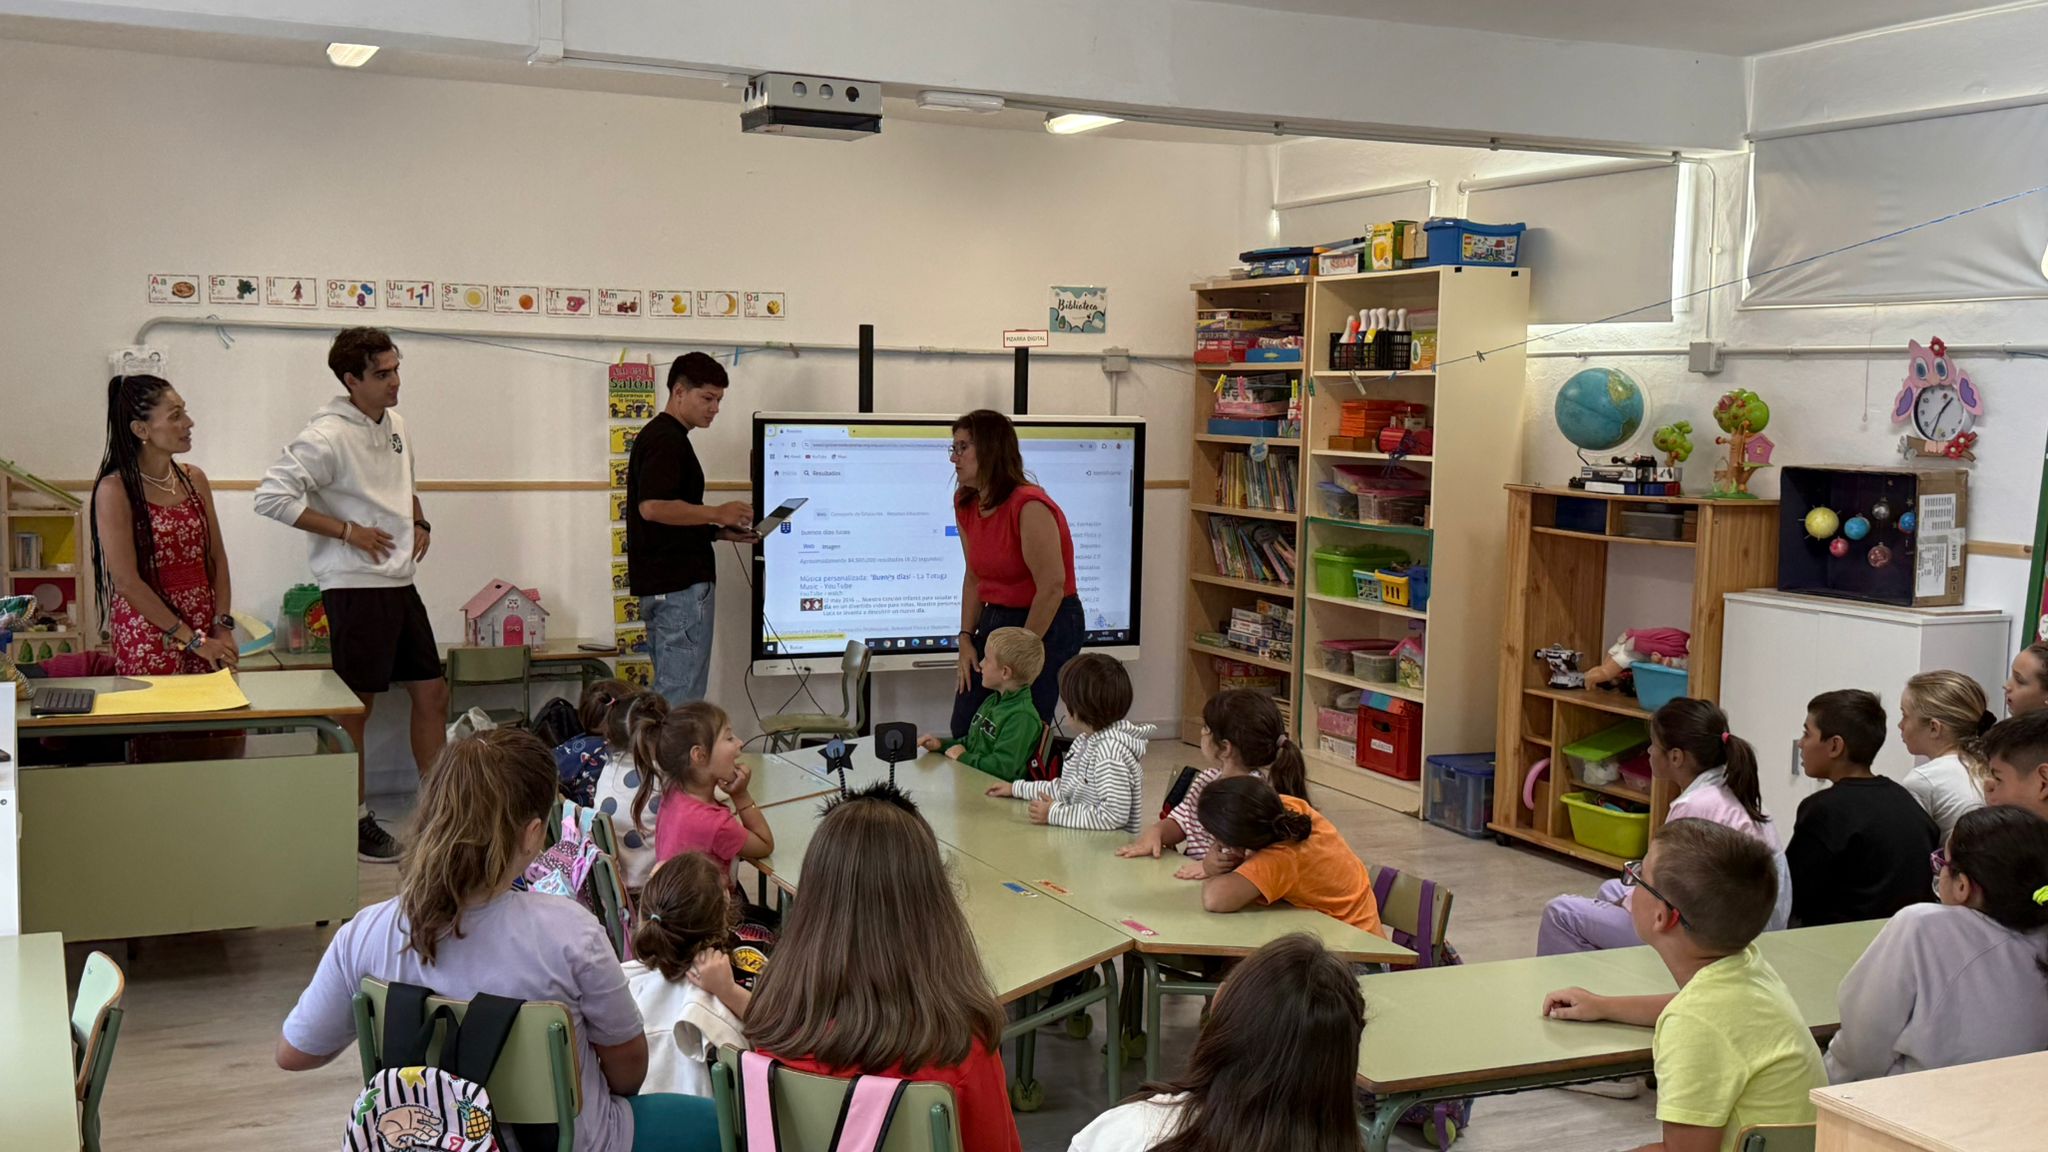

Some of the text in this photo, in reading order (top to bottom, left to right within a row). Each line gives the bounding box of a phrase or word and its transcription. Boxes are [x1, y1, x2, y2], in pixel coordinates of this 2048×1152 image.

[152, 276, 167, 285] Aa
[330, 282, 345, 290] Oo
[389, 282, 403, 290] Uu
[445, 285, 458, 294] Ss
[496, 288, 510, 296] Nn
[601, 291, 617, 299] Mm
[652, 293, 664, 301] Pp
[747, 294, 759, 302] Dd
[1058, 298, 1098, 311] Biblioteca
[610, 376, 654, 389] Salón
